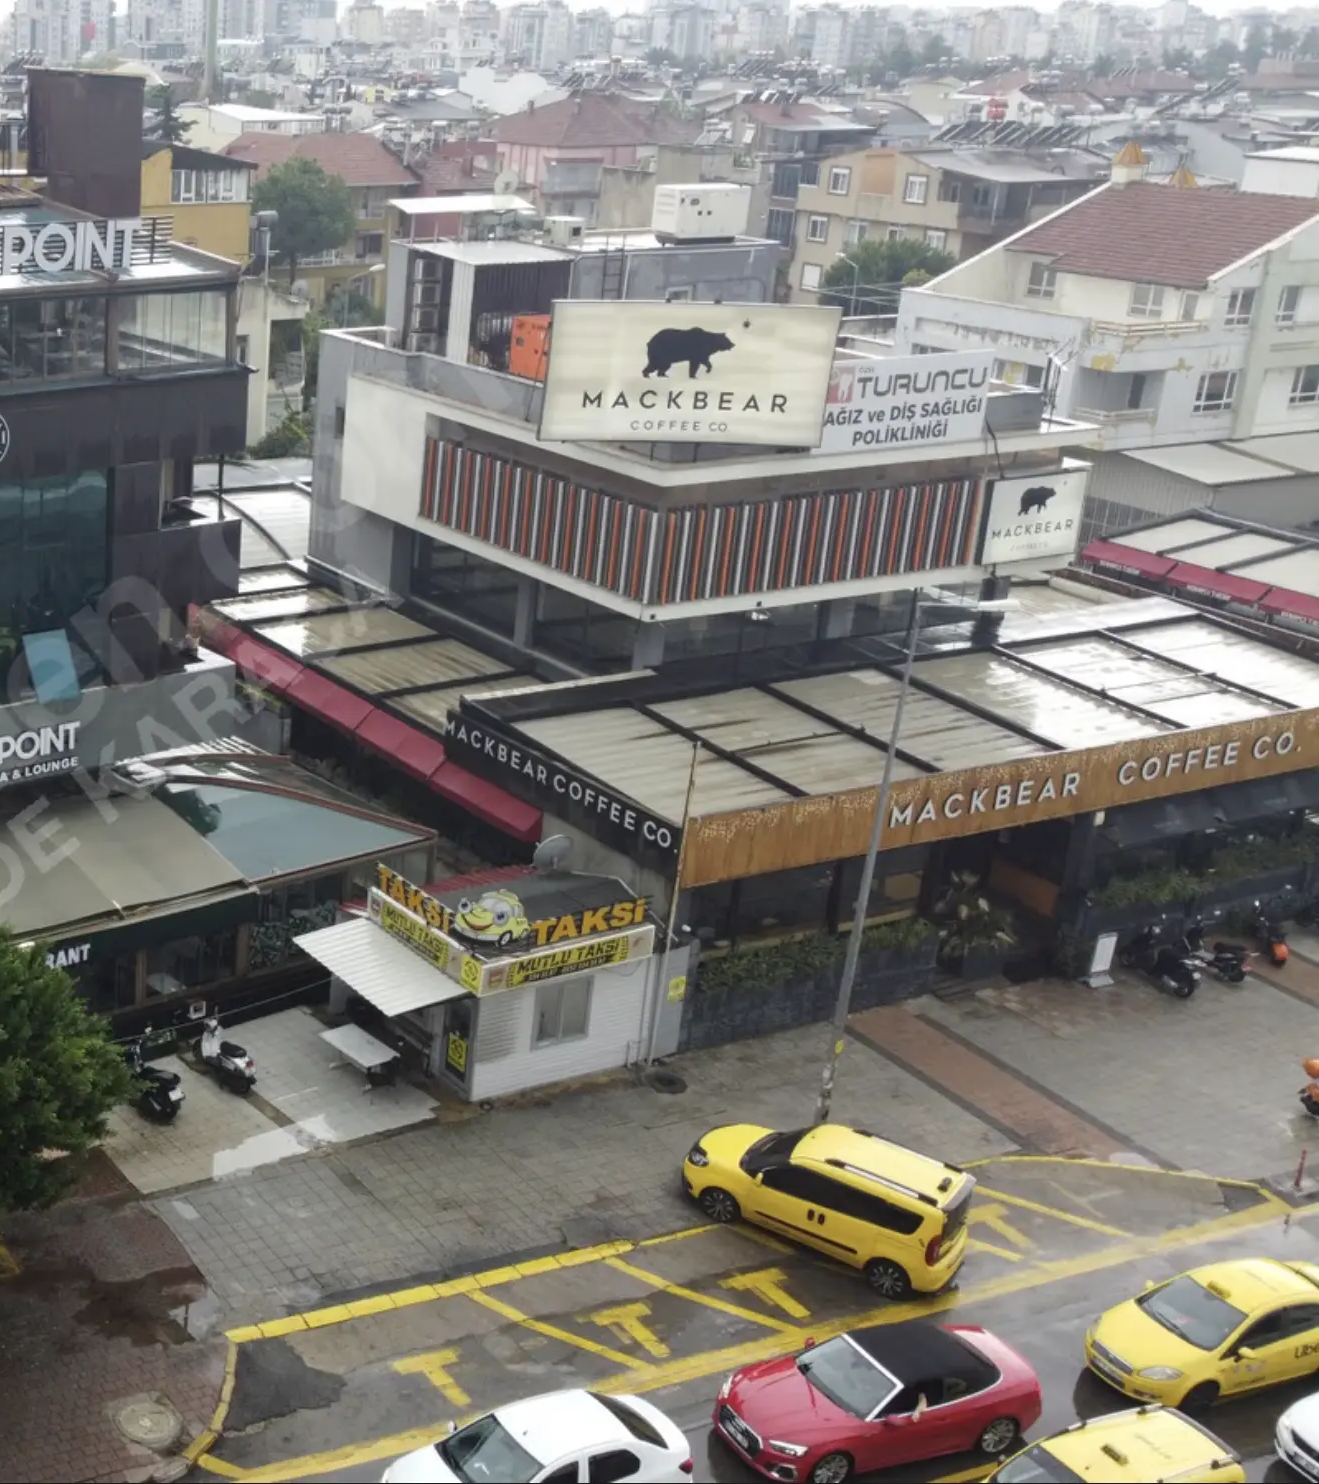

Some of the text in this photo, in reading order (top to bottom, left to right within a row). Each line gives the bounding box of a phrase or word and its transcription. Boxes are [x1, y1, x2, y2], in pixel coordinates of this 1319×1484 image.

[3, 219, 142, 276] POINT
[857, 367, 988, 398] TURUNCU
[582, 390, 787, 413] MACKBEAR
[823, 396, 982, 427] AĞIZ ve DİŞ SAĞLIĞI
[631, 420, 701, 431] COFFEE
[852, 419, 948, 446] POLİKLİNİĞİ
[991, 519, 1074, 540] MACKBEAR
[12, 769, 21, 779] &
[25, 756, 79, 777] LOUNGE
[443, 719, 548, 785] MACKBEAR
[553, 774, 637, 831] COFFEE
[890, 772, 1081, 829] MACKBEAR
[1118, 741, 1242, 786] COFFEE
[531, 898, 647, 946] TAKSİ
[516, 949, 572, 974] MUTLU
